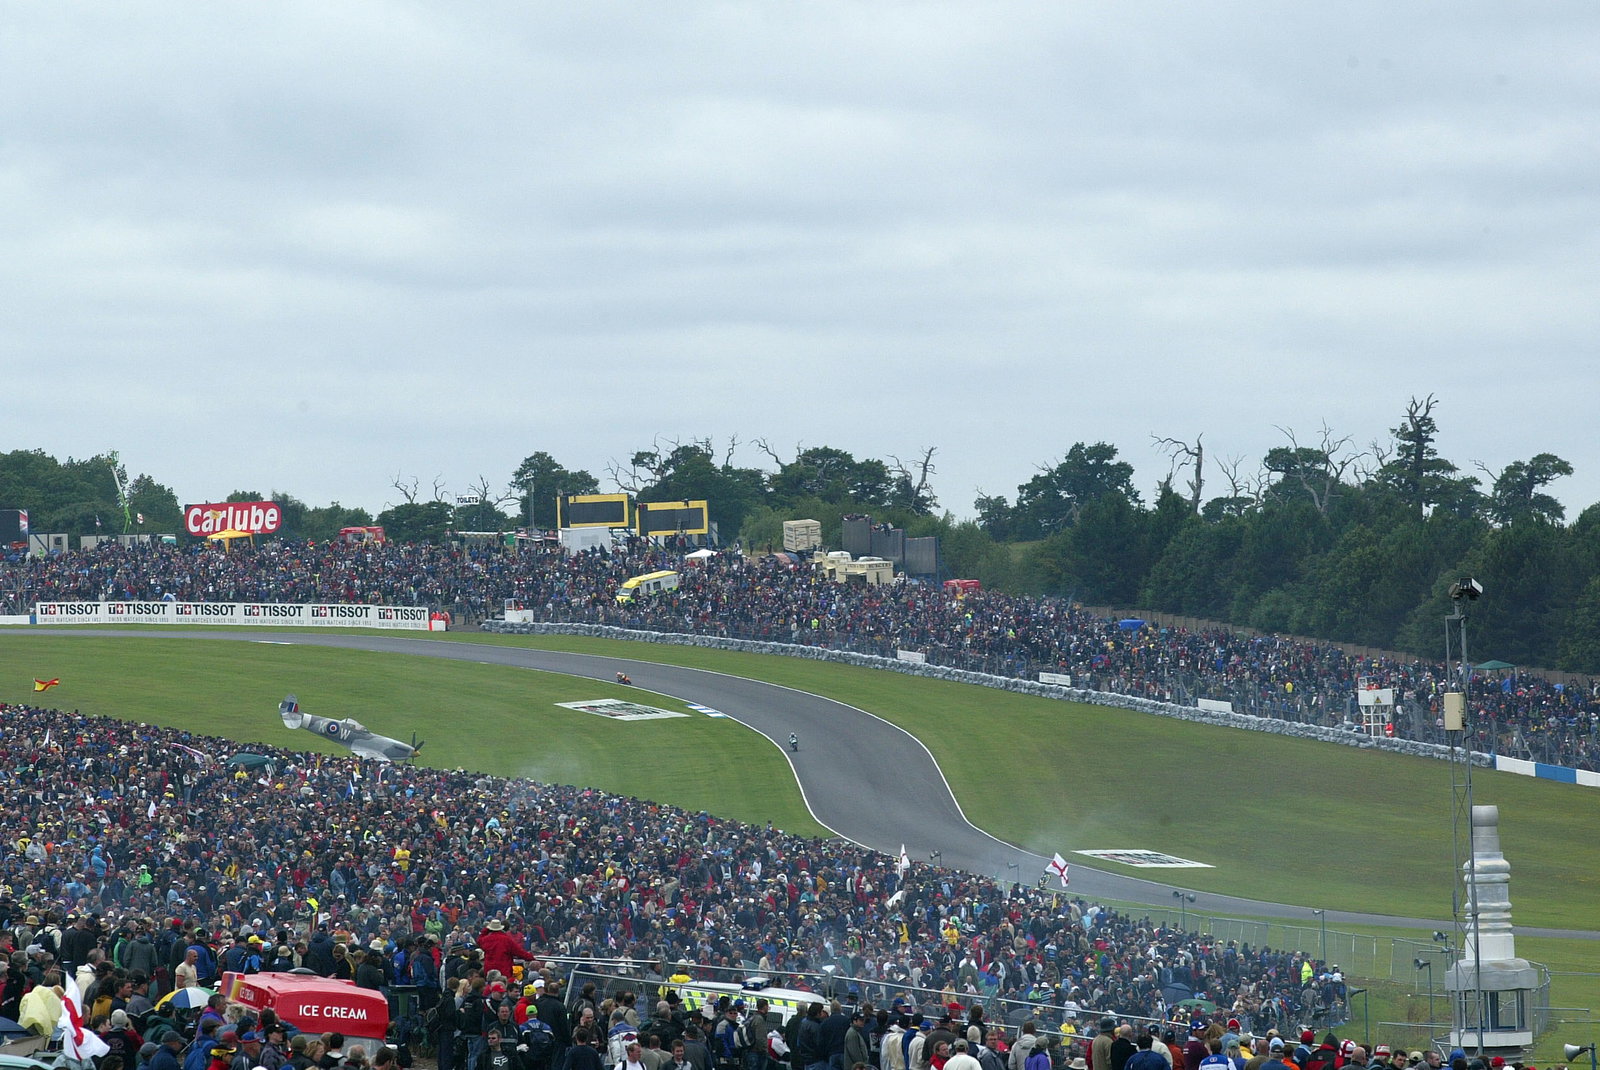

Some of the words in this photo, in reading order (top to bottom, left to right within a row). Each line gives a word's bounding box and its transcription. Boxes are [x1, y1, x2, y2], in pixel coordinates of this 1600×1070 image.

[188, 505, 278, 533] Carlube
[57, 604, 101, 615] TISSOT
[125, 604, 168, 615] TISSOT
[192, 604, 236, 616] TISSOT
[260, 605, 303, 617] TISSOT
[328, 606, 371, 618] TISSOT
[392, 609, 426, 620] TISSOT
[340, 728, 350, 740] W
[299, 1004, 319, 1017] ICE
[323, 1005, 367, 1020] CREAM
